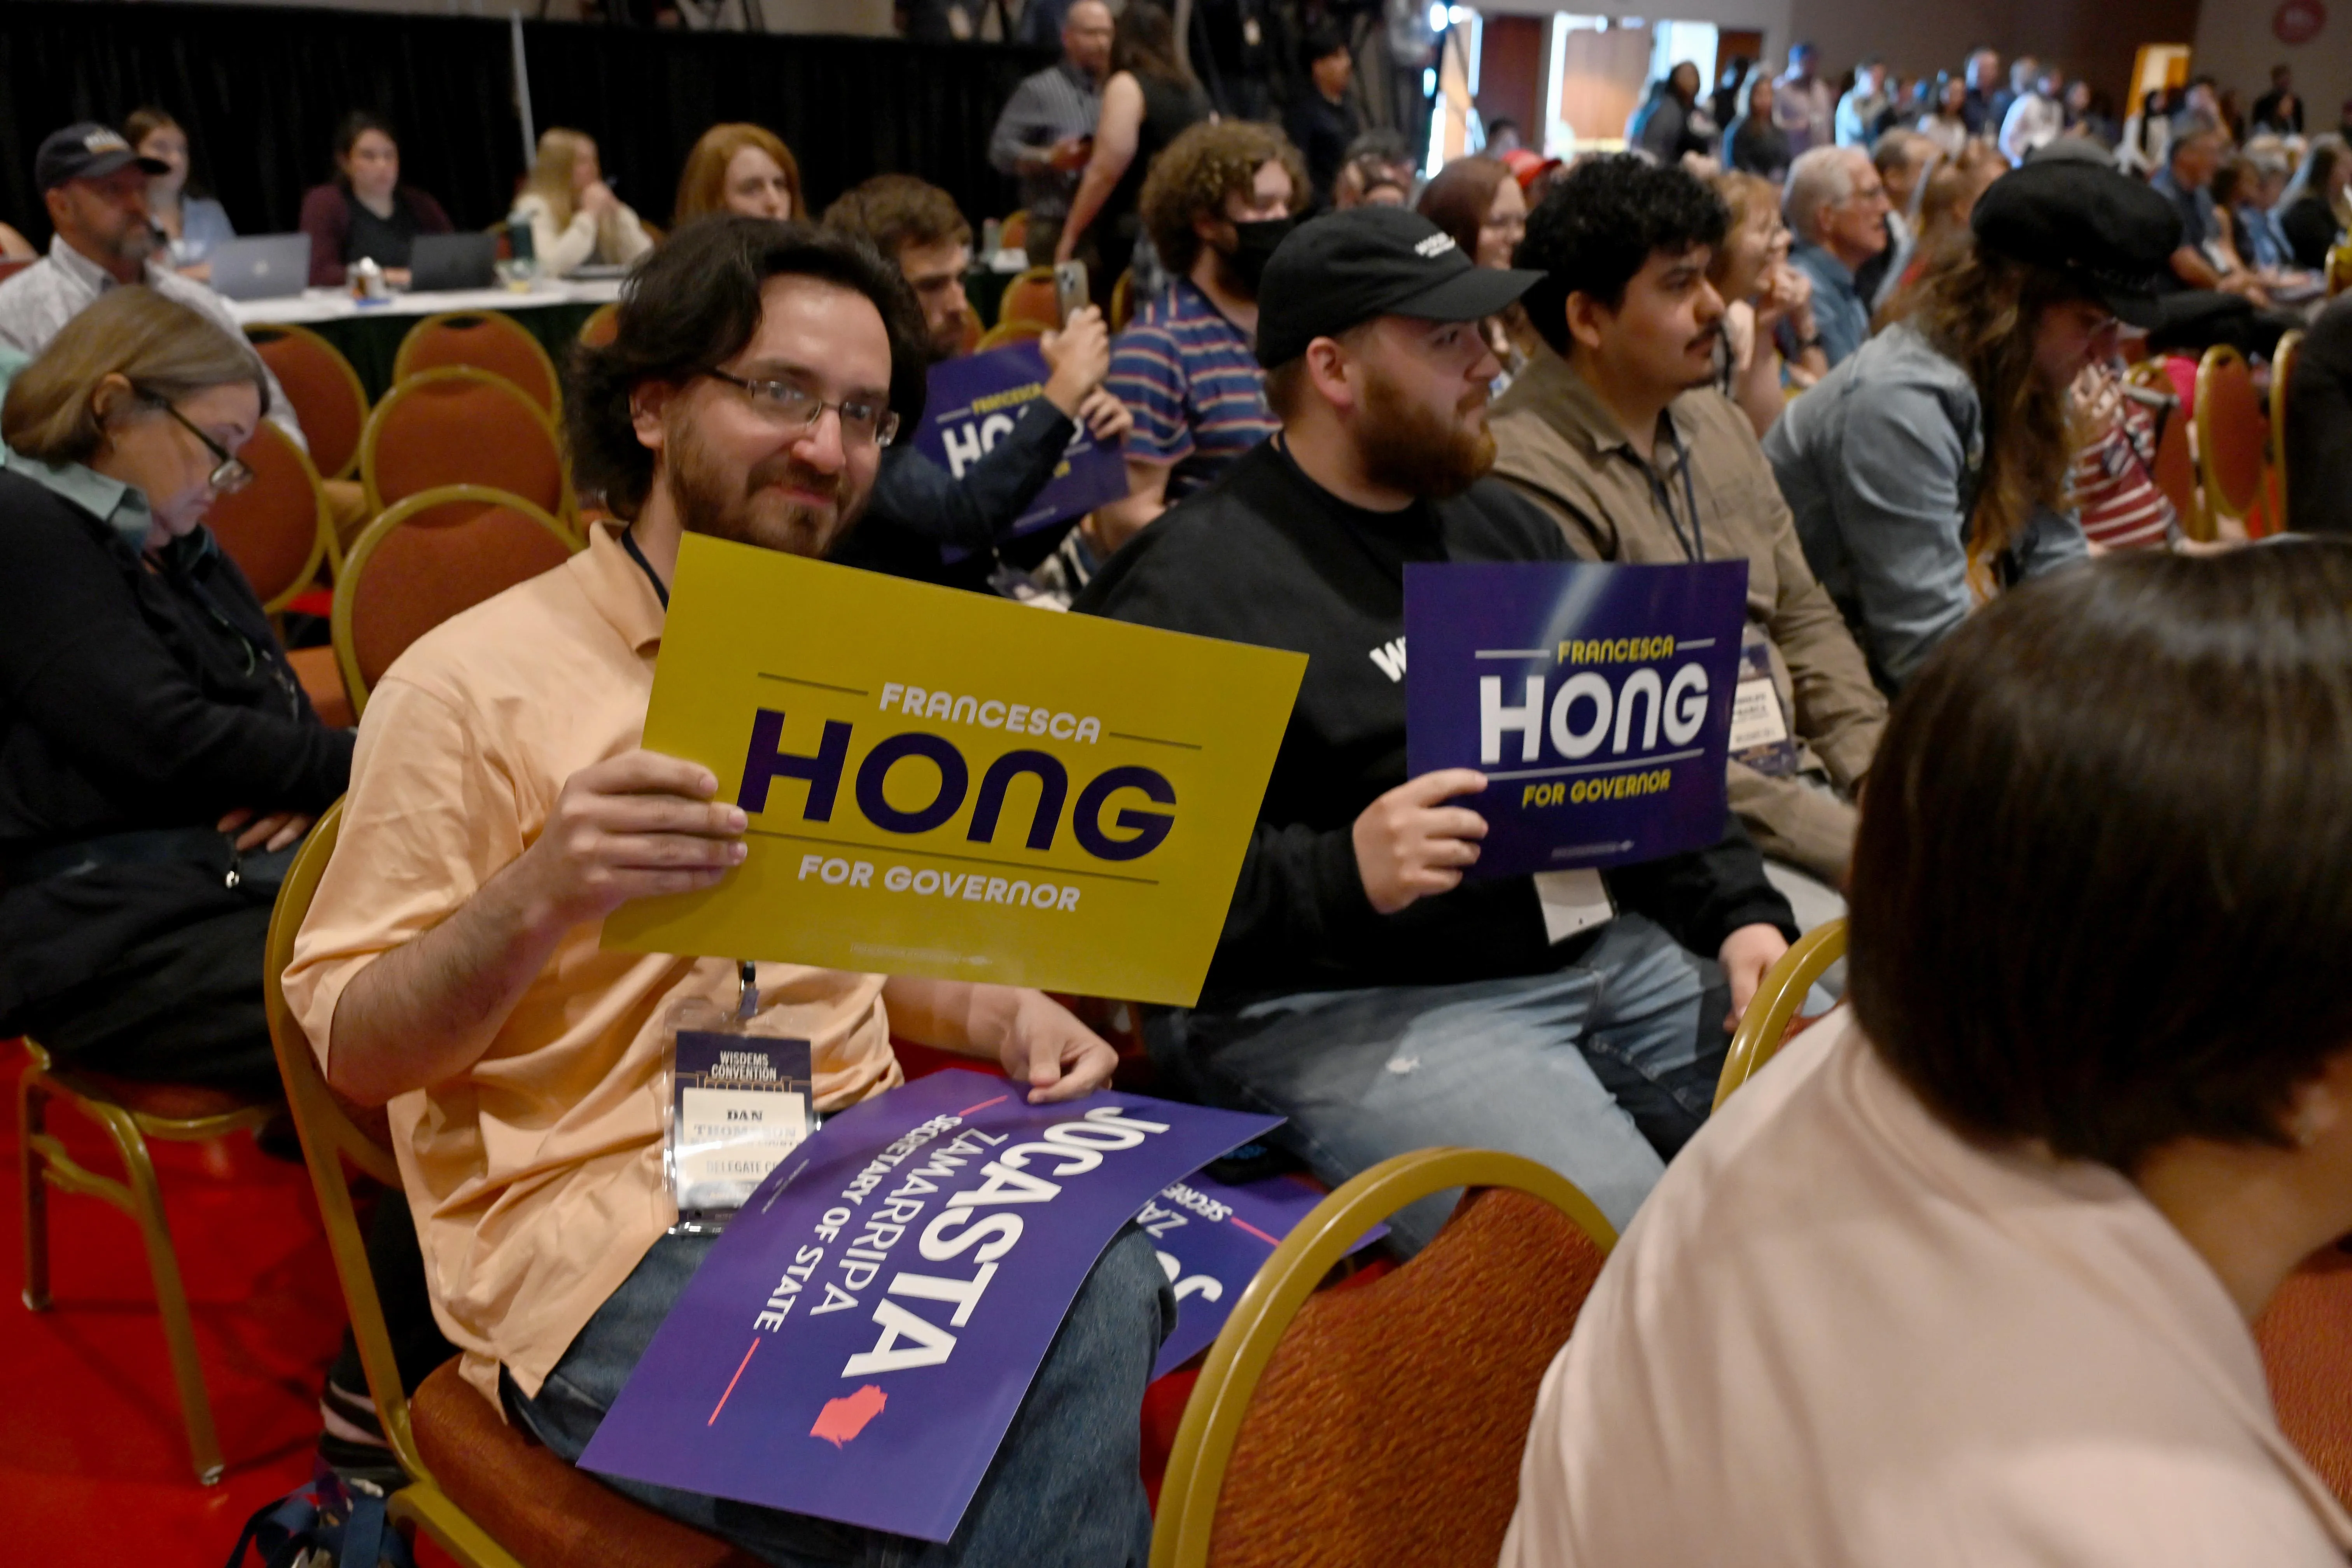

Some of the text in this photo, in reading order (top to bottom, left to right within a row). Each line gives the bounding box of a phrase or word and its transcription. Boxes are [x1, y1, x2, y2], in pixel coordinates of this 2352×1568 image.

[1558, 635, 1675, 664] FRANCESCA
[879, 683, 1101, 744] FRANCESCA
[1480, 663, 1708, 764] HONG
[736, 708, 1177, 862] HONG
[1522, 769, 1671, 808] FOR GOVERNOR
[798, 855, 1080, 912] FOR GOVERNOR
[711, 1063, 777, 1082] CONVENTION
[720, 1050, 768, 1068] WISDEMS
[727, 1110, 763, 1121] DAN
[840, 1113, 962, 1206] SECRETARY
[810, 1127, 1009, 1316] ZAMARRIPA
[814, 1206, 851, 1243] OF
[841, 1106, 1170, 1378] JOCASTA
[752, 1244, 824, 1333] STATE
